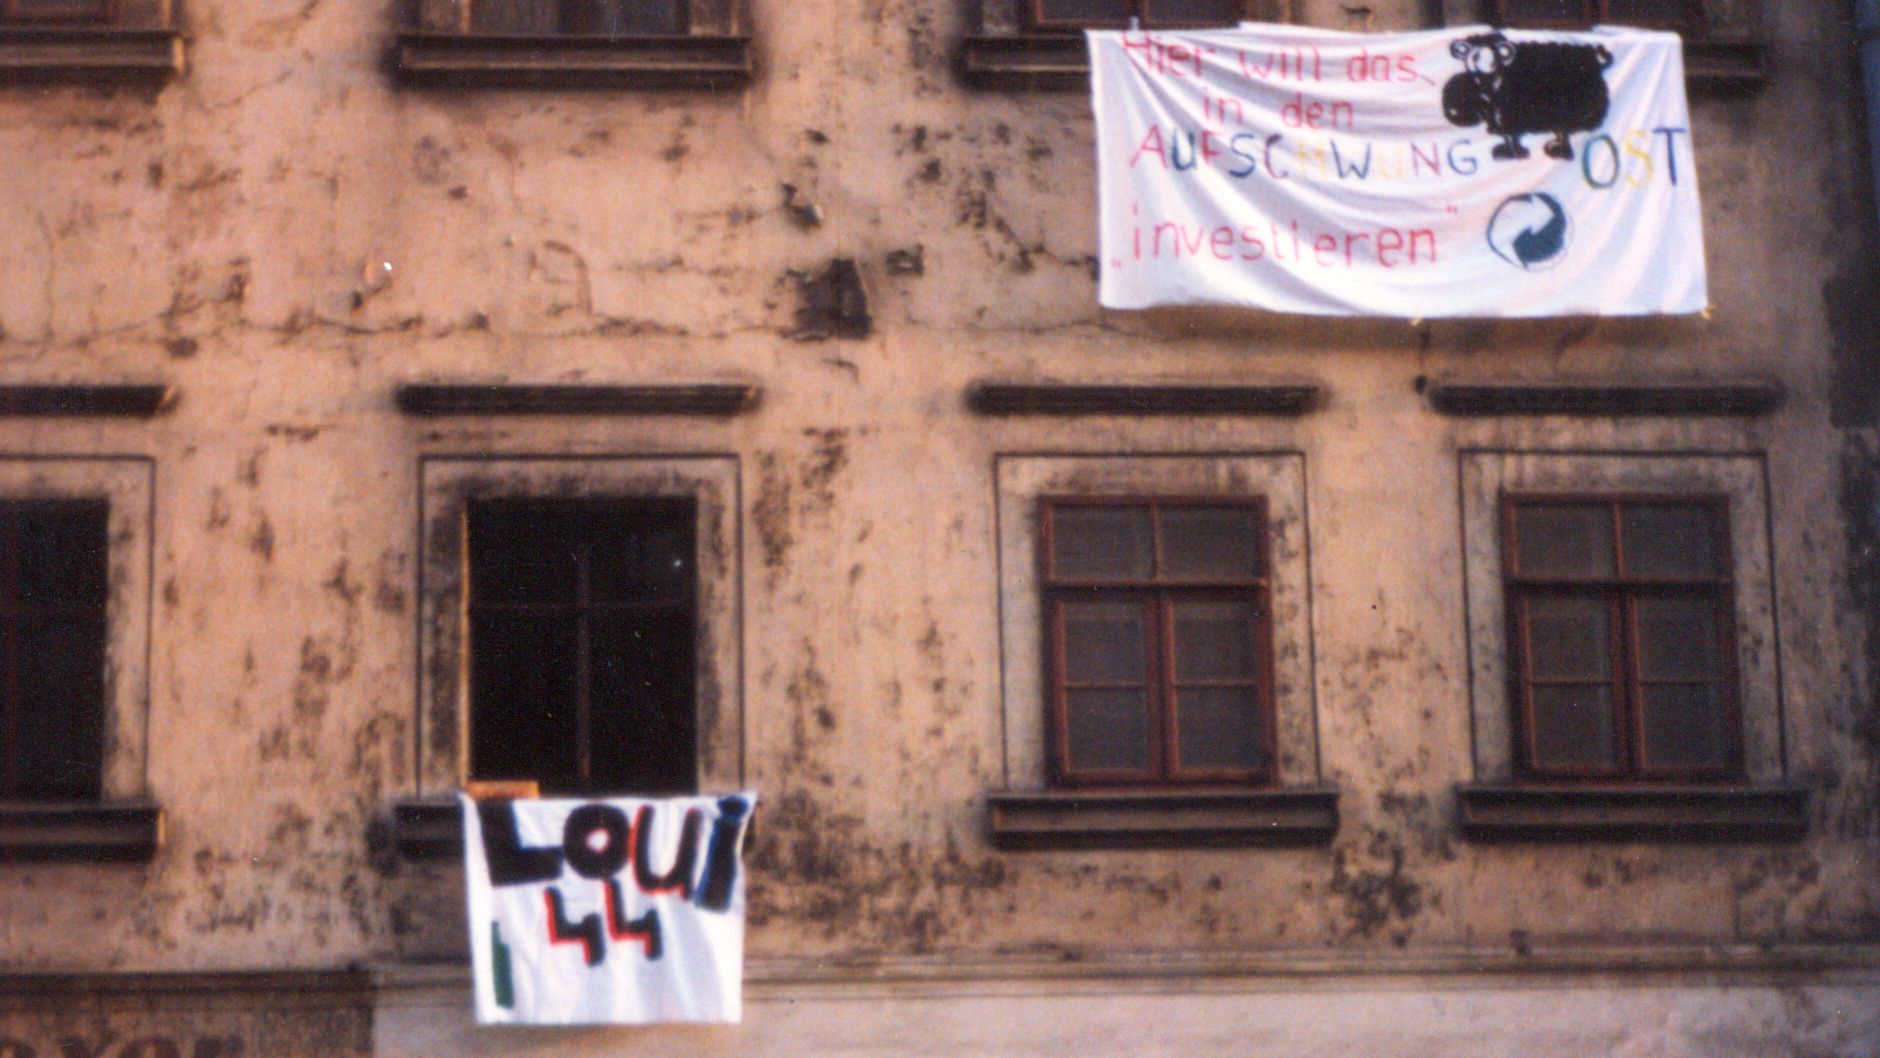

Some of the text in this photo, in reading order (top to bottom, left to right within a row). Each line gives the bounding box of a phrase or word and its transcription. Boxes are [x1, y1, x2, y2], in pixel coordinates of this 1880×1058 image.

[1122, 31, 1217, 78] Hier
[1237, 47, 1321, 81] will
[1202, 86, 1354, 128] in den
[1129, 124, 1686, 190] AUFSCHWUNG OST
